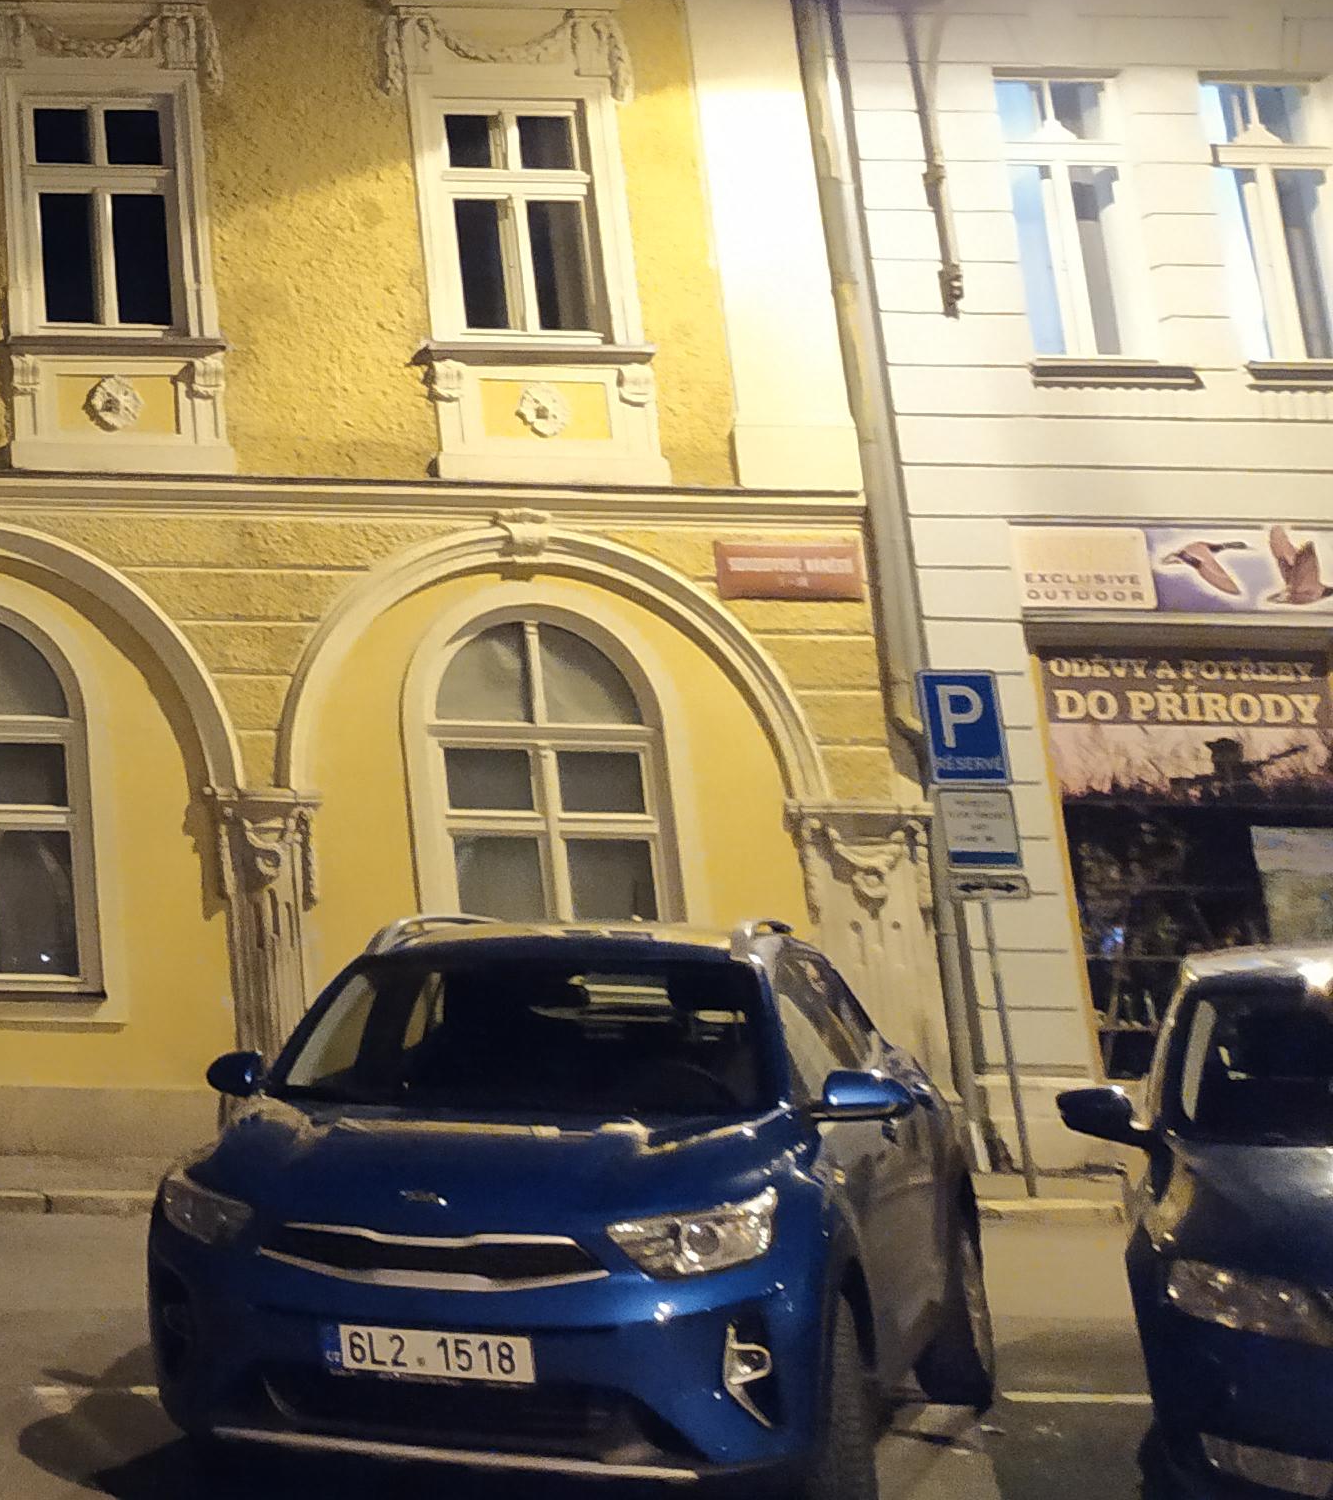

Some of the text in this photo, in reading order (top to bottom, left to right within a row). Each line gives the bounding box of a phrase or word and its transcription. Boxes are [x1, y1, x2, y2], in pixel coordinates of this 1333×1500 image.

[1024, 573, 1141, 585] EXCLUSIVE
[1026, 589, 1145, 601] OUTDOOR
[1154, 659, 1180, 679] A
[936, 685, 984, 748] P
[1052, 684, 1321, 724] DO PŘÍRODY
[349, 1332, 516, 1375] 6L2 1518
